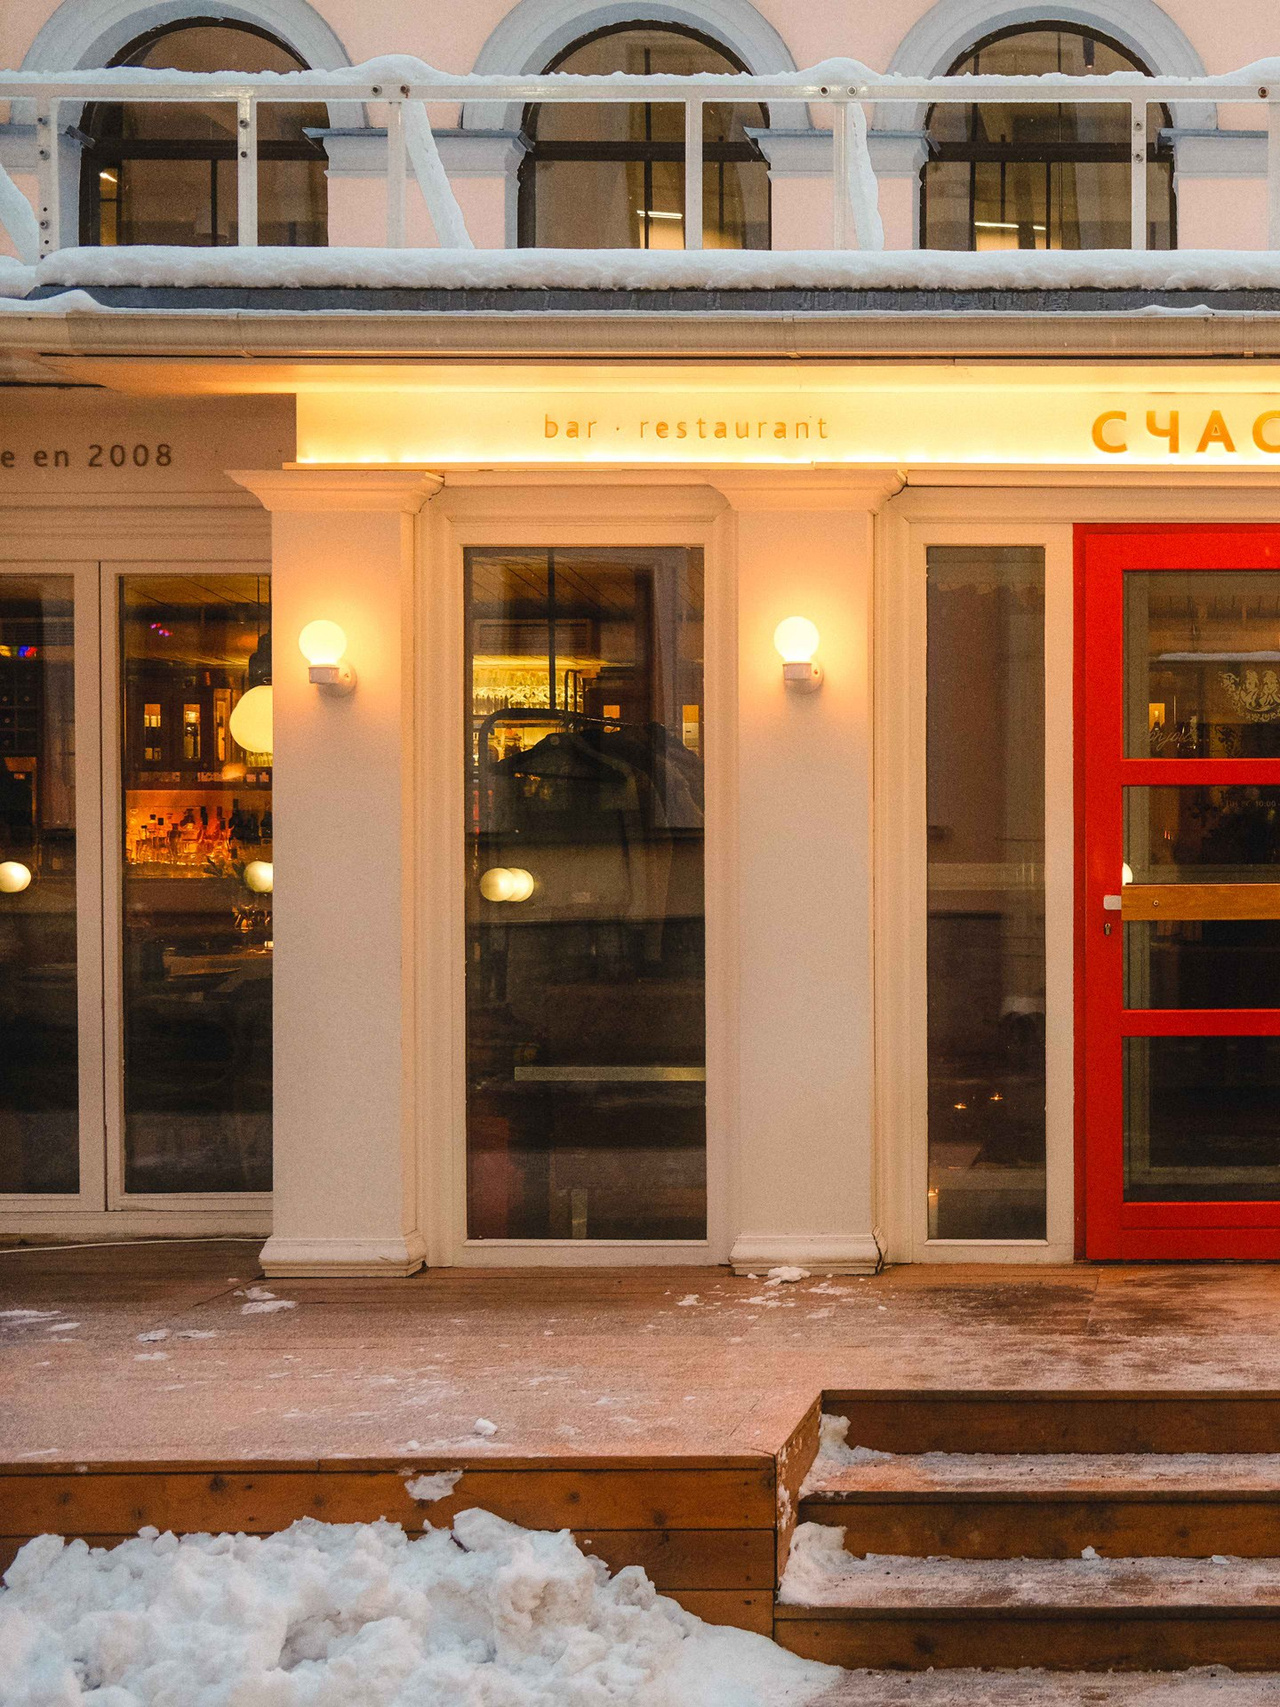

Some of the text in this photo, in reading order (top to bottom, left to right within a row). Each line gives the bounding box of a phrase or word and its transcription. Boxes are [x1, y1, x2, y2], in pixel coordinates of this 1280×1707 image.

[543, 412, 598, 440] bar
[639, 416, 829, 440] restaurant
[32, 449, 71, 468] en
[87, 442, 173, 468] 2008
